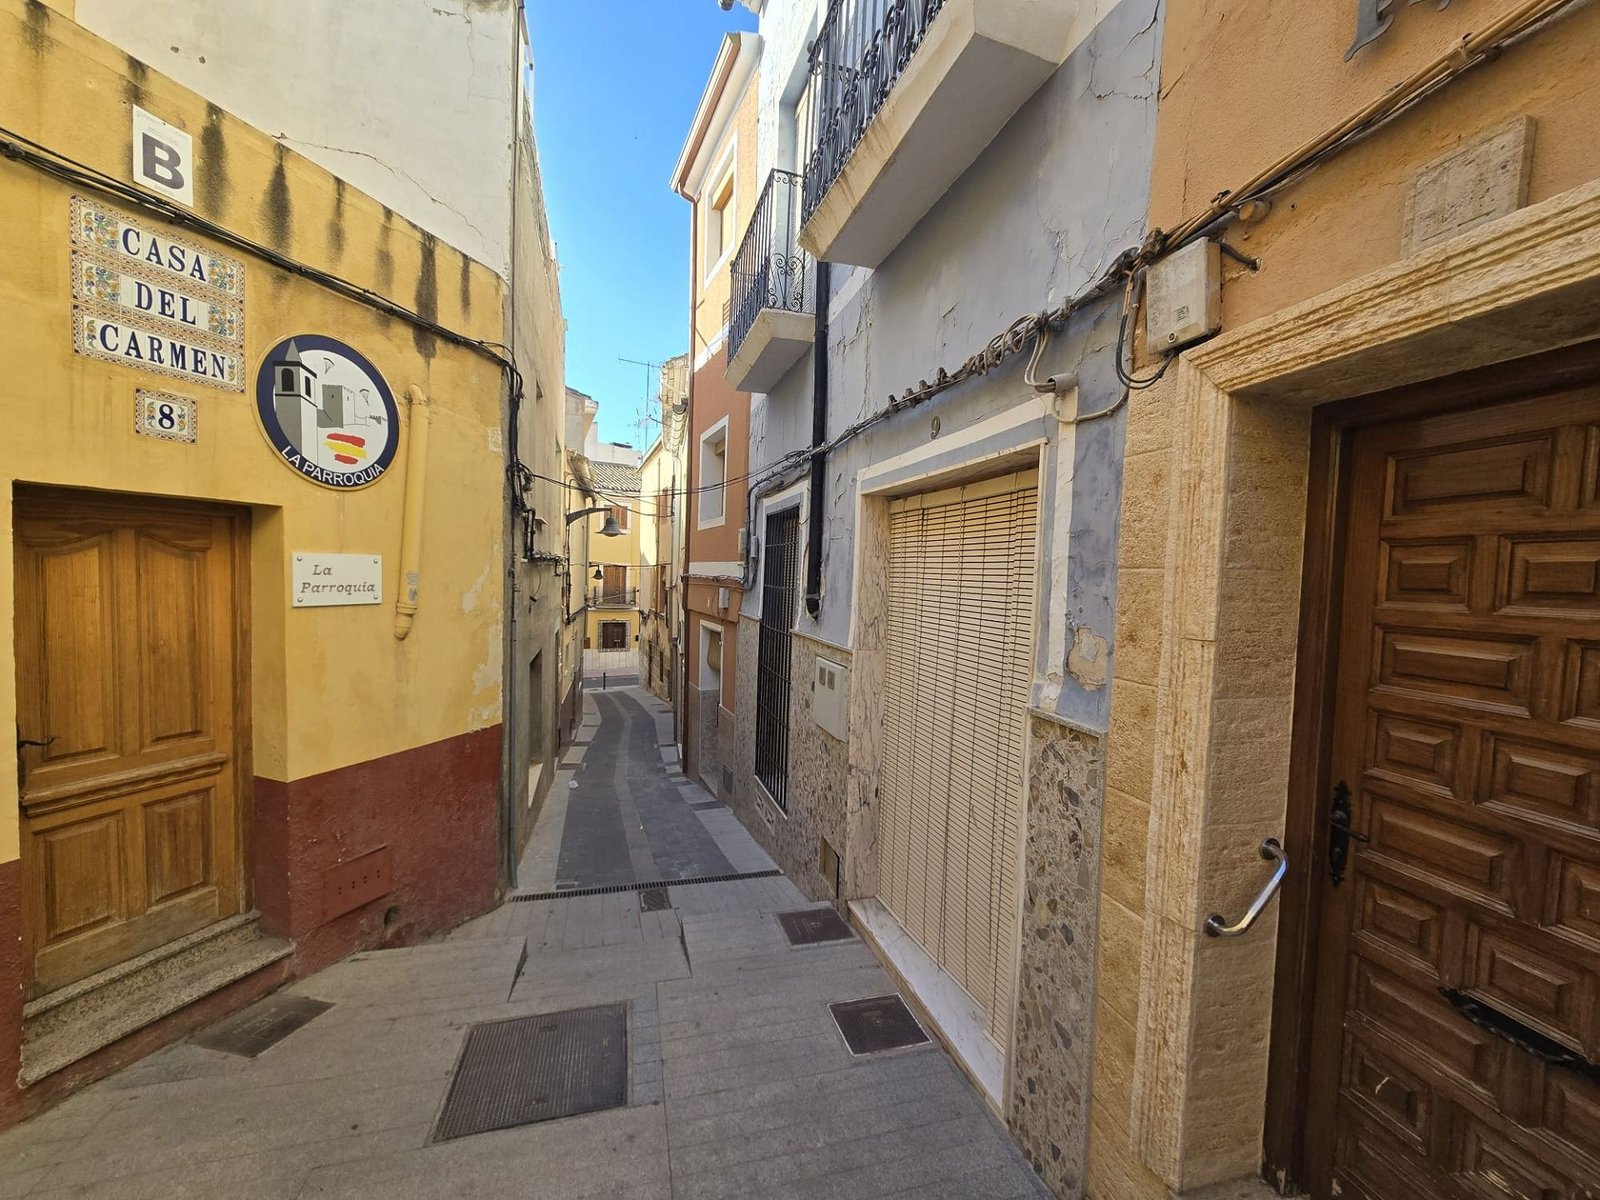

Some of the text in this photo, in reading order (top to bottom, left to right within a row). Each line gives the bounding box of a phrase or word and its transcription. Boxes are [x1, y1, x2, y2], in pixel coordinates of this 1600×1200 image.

[142, 132, 184, 189] B
[122, 227, 207, 282] CASA
[135, 281, 197, 326] DEL
[99, 324, 226, 380] CARMEN
[158, 403, 175, 430] 8
[282, 446, 385, 486] LA PARROQUIA
[300, 581, 376, 596] Parroquia
[312, 564, 332, 576] La
